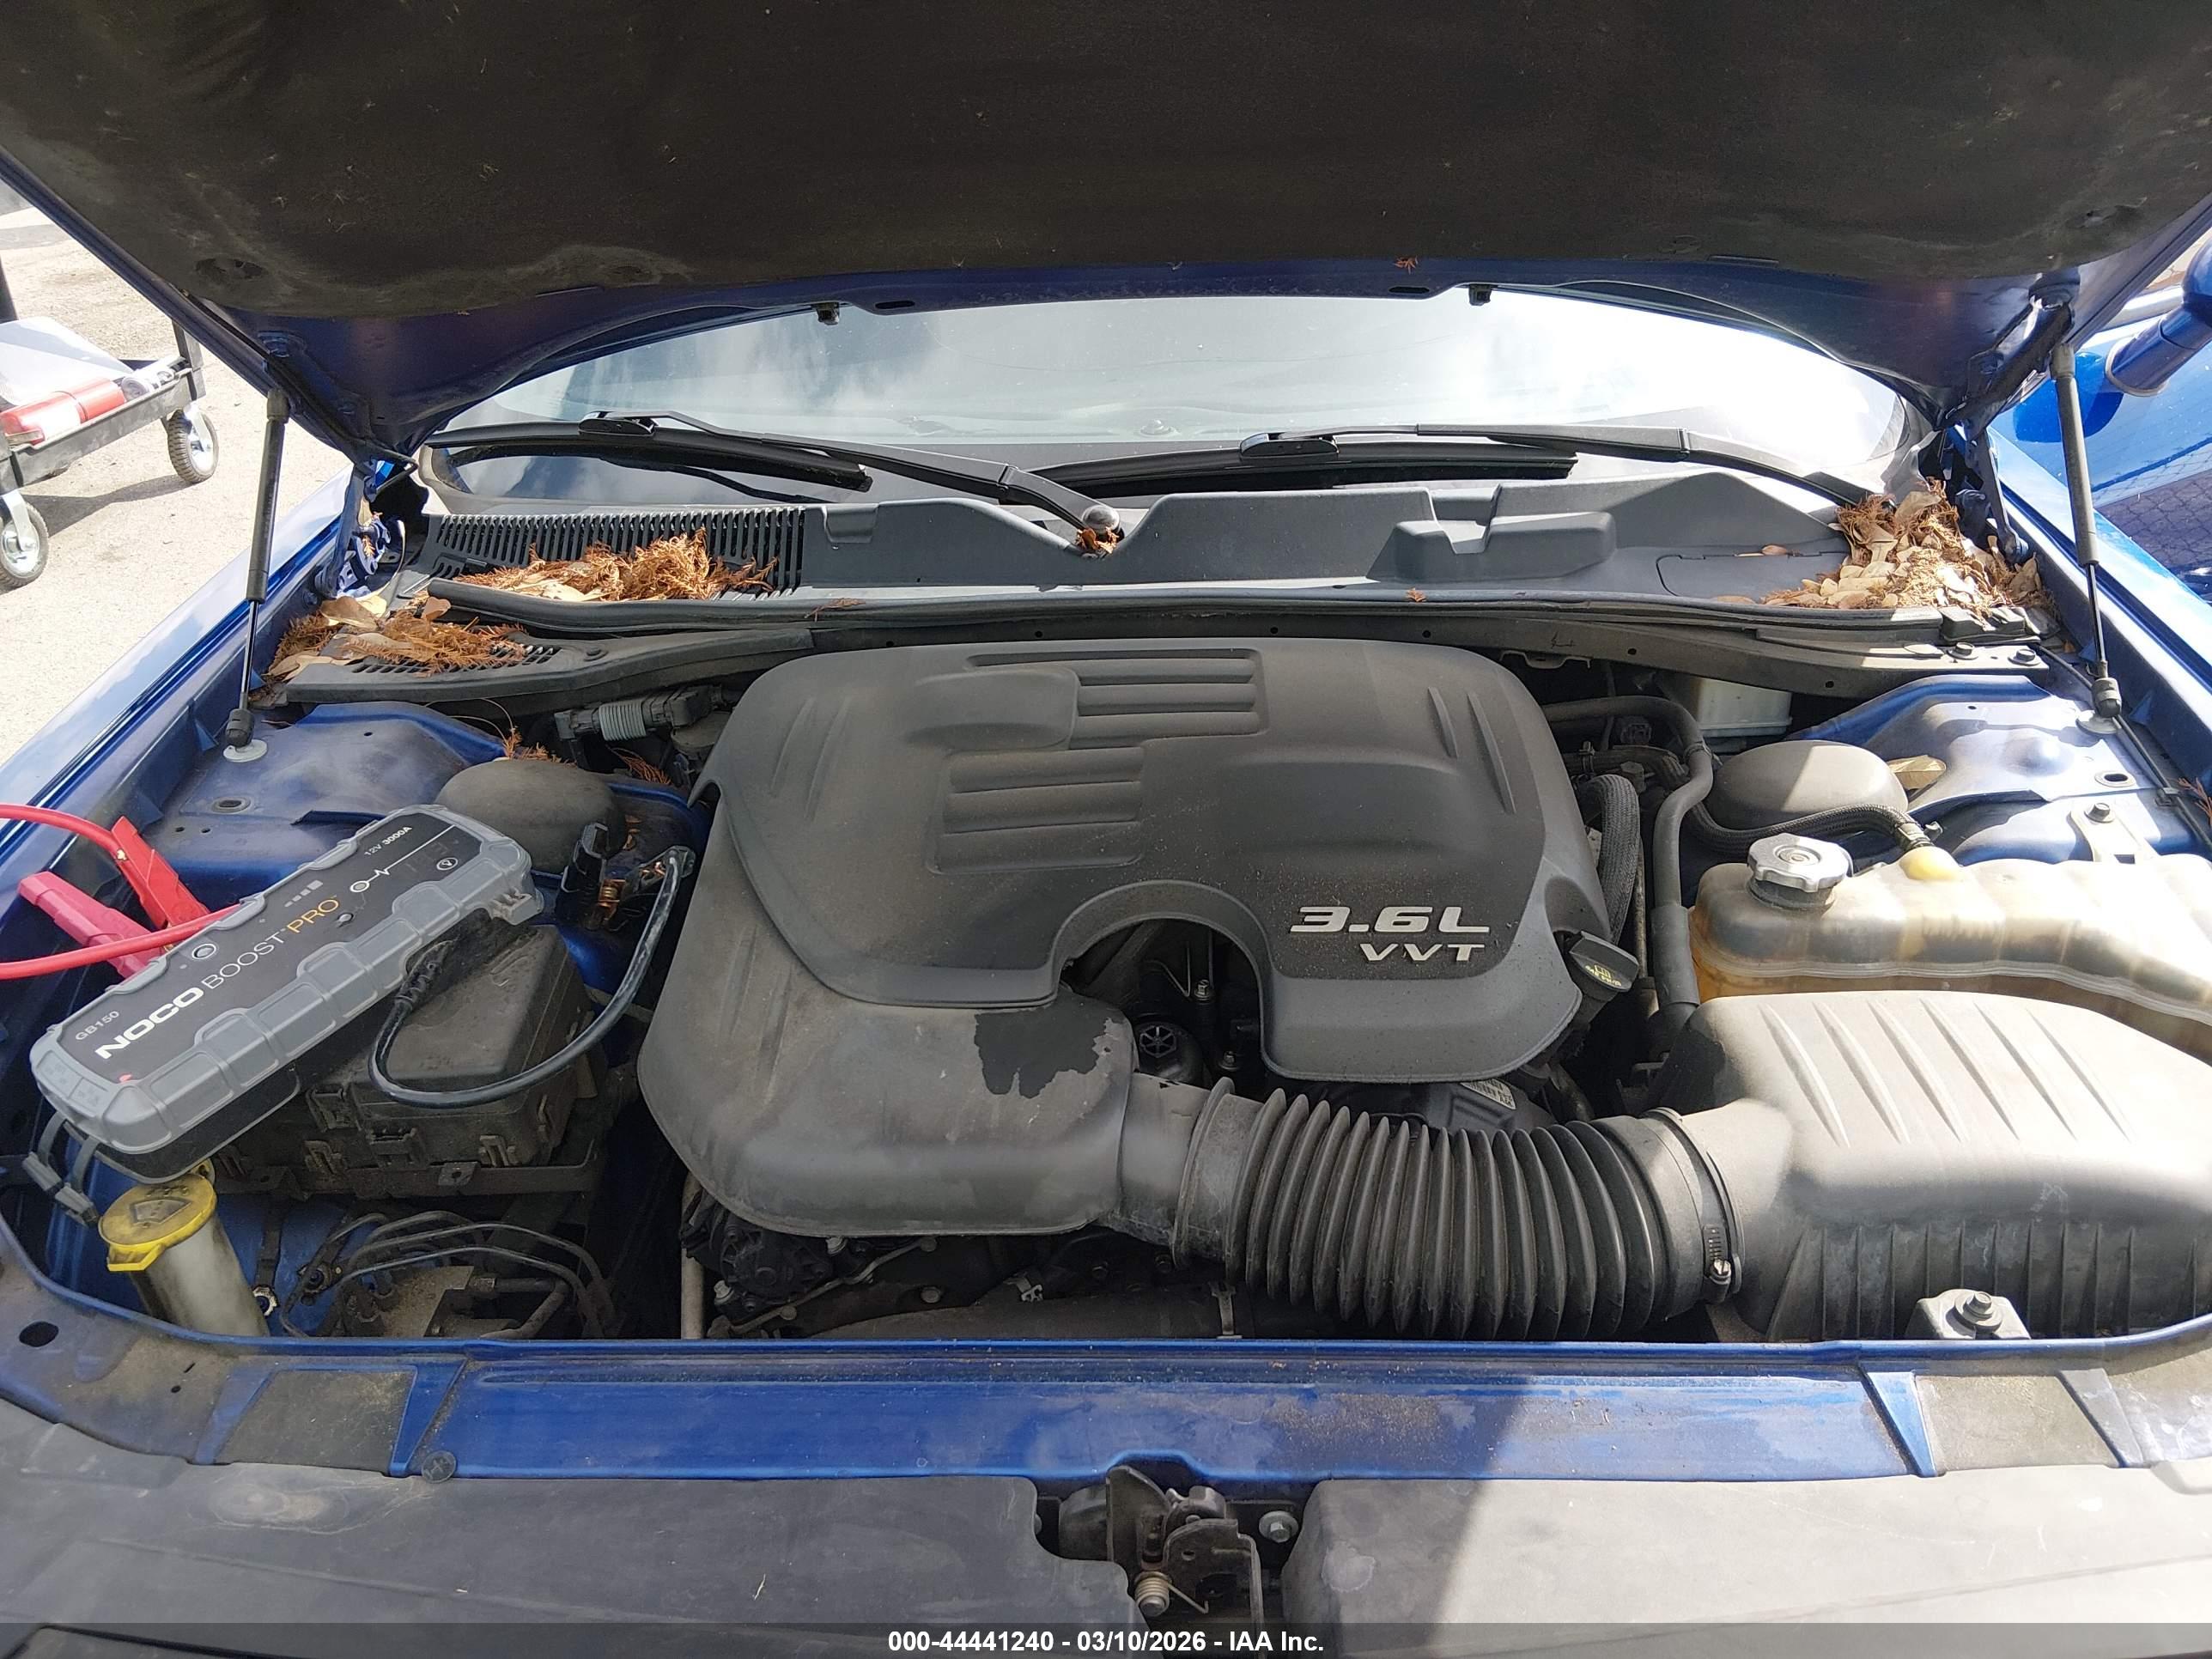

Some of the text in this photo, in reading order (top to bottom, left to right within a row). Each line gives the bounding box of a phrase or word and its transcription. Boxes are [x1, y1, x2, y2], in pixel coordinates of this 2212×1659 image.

[364, 826, 412, 856] 12V 3000A
[1290, 905, 1490, 934] 3.6L
[1359, 943, 1486, 962] VVT
[94, 899, 339, 1060] NOCO BOOST PRO
[75, 1011, 120, 1041] GB150
